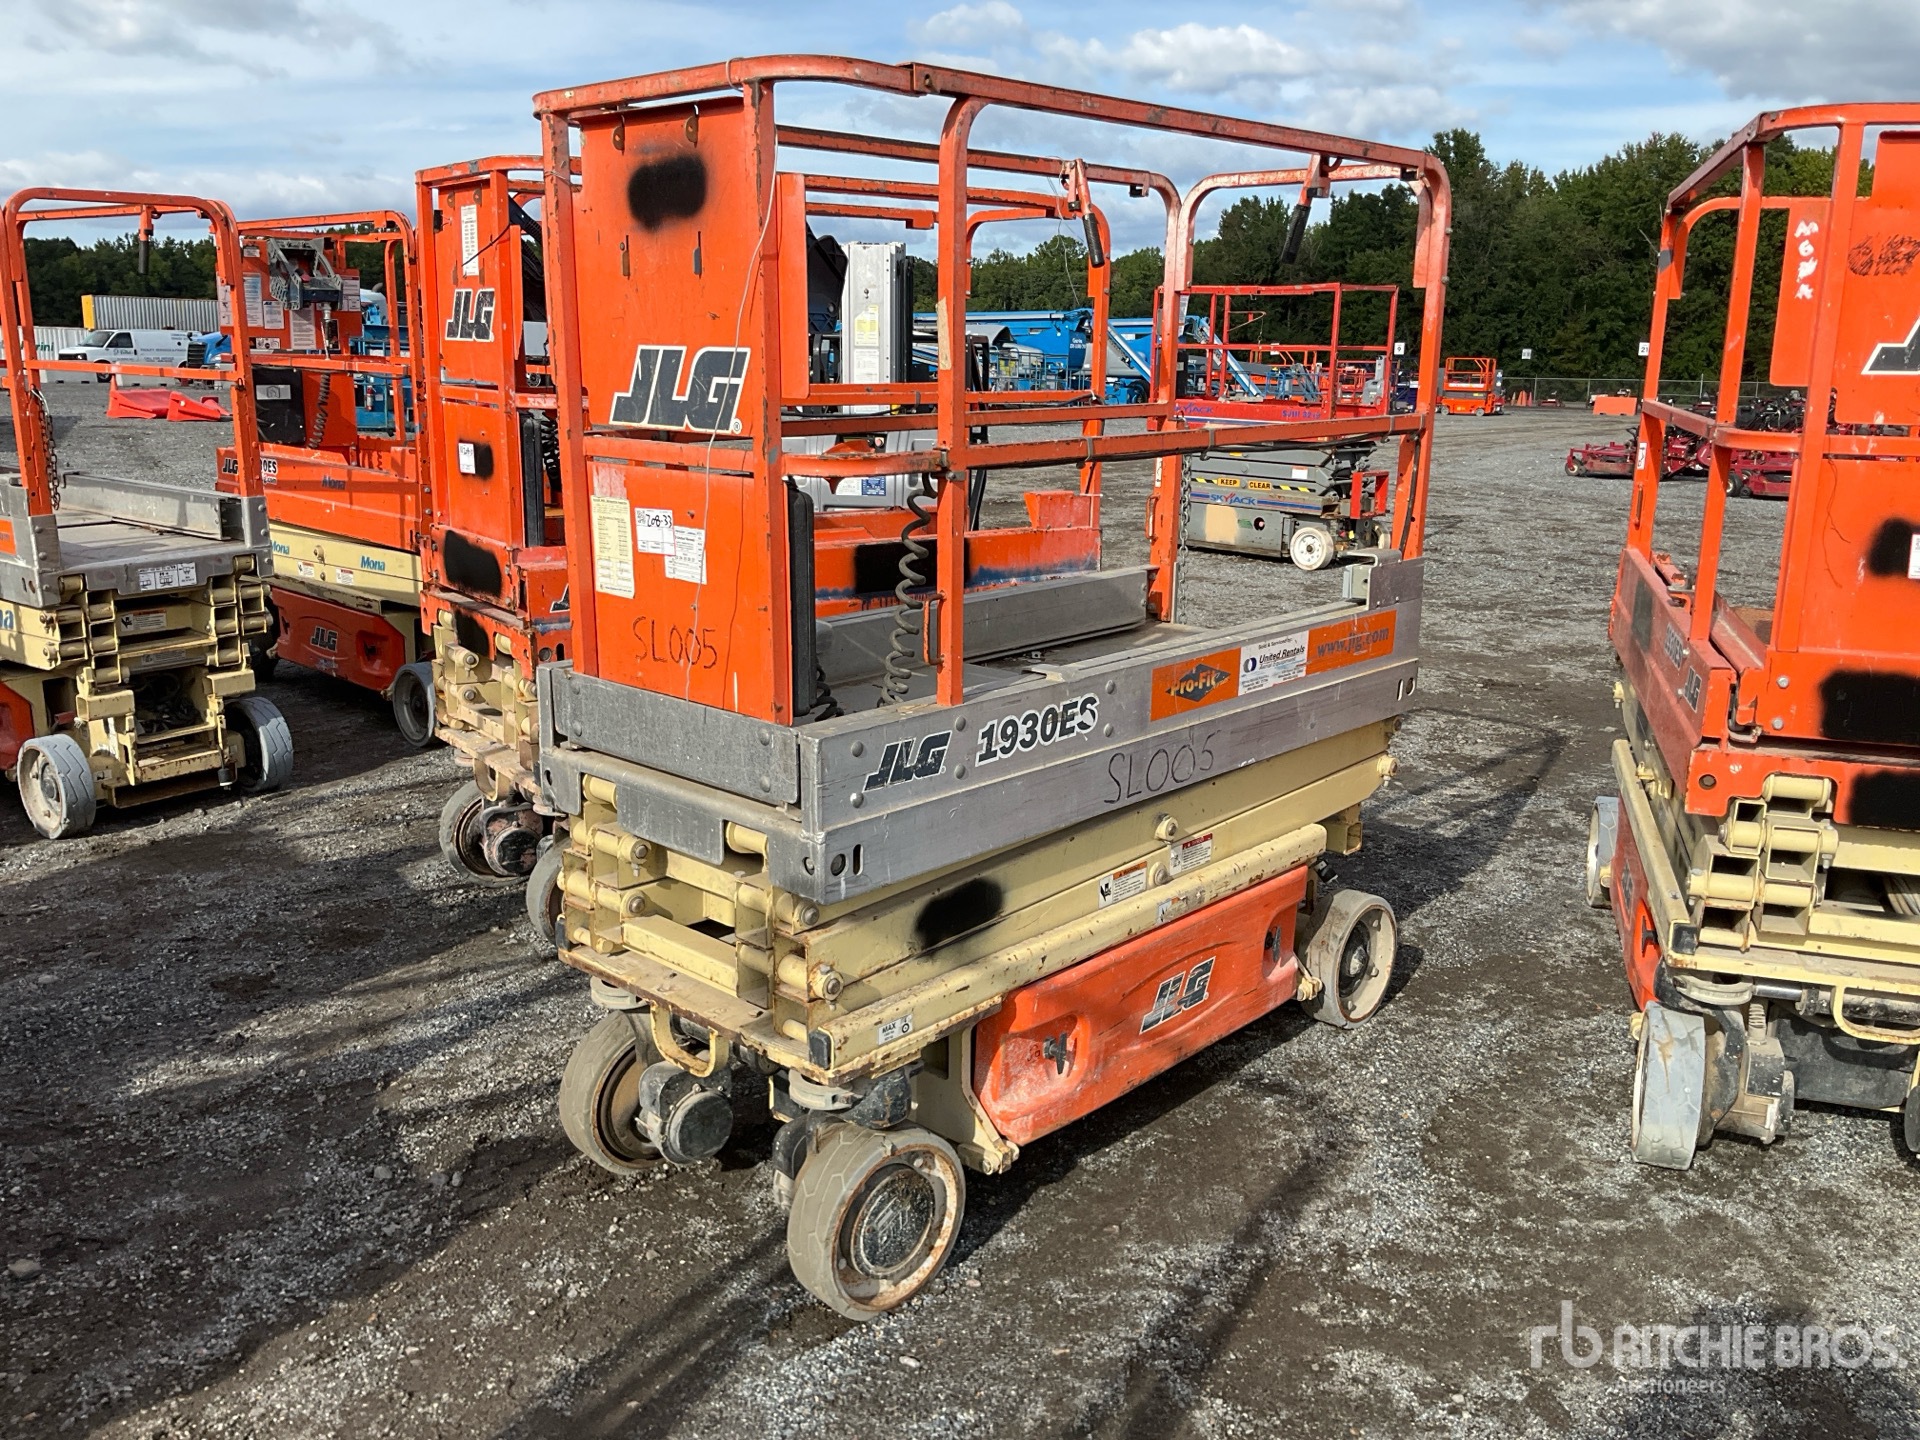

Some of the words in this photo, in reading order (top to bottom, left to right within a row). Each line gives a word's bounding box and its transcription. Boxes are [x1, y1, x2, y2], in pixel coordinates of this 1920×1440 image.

[445, 288, 495, 342] JLG
[610, 345, 751, 434] JLG
[223, 458, 238, 474] JLG
[1220, 478, 1238, 486] KEEP
[1249, 481, 1271, 490] CLEAR
[1210, 492, 1256, 505] SKYJACK
[360, 555, 386, 571] Mona
[310, 625, 338, 652] JLG
[632, 616, 718, 669] SL005
[1259, 650, 1281, 664] United
[1281, 645, 1305, 659] Rentals
[864, 731, 951, 792] JLG
[975, 692, 1100, 767] 1930ES
[1140, 956, 1216, 1034] JLG
[882, 1022, 896, 1033] MAX
